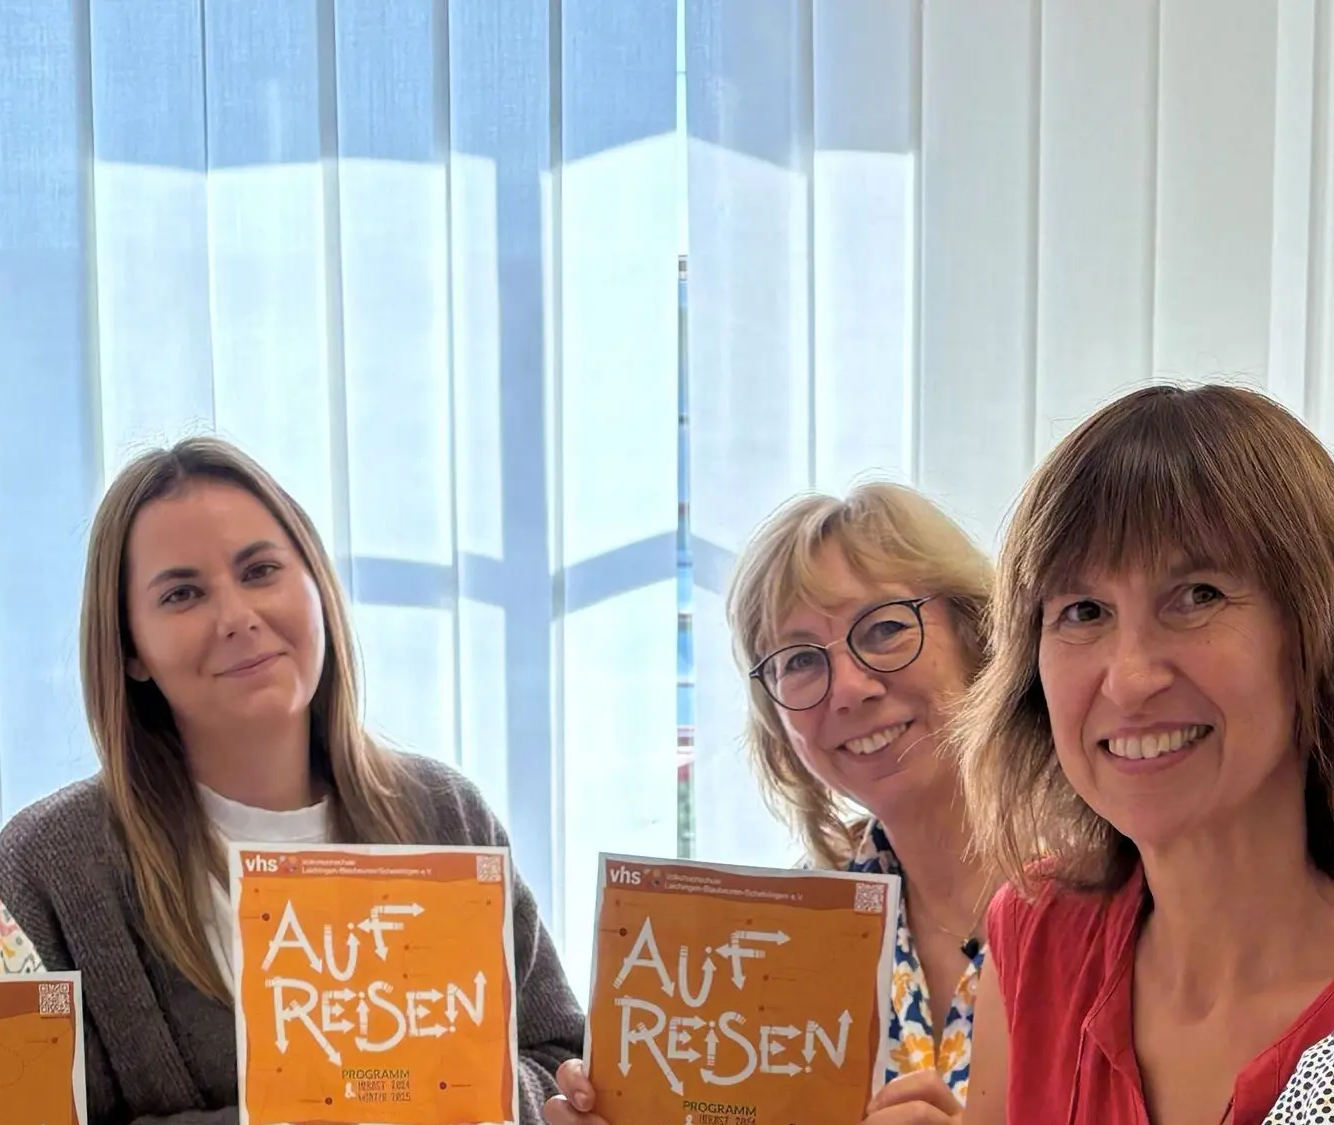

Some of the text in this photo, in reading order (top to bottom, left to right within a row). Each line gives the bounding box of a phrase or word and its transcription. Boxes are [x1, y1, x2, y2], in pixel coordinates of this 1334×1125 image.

[245, 855, 278, 872] vhs
[610, 867, 642, 885] vhs
[261, 900, 425, 981] AUF
[613, 916, 791, 1007] AUF
[342, 1069, 409, 1079] PROGRAMM
[683, 1100, 756, 1116] PROGRAMM
